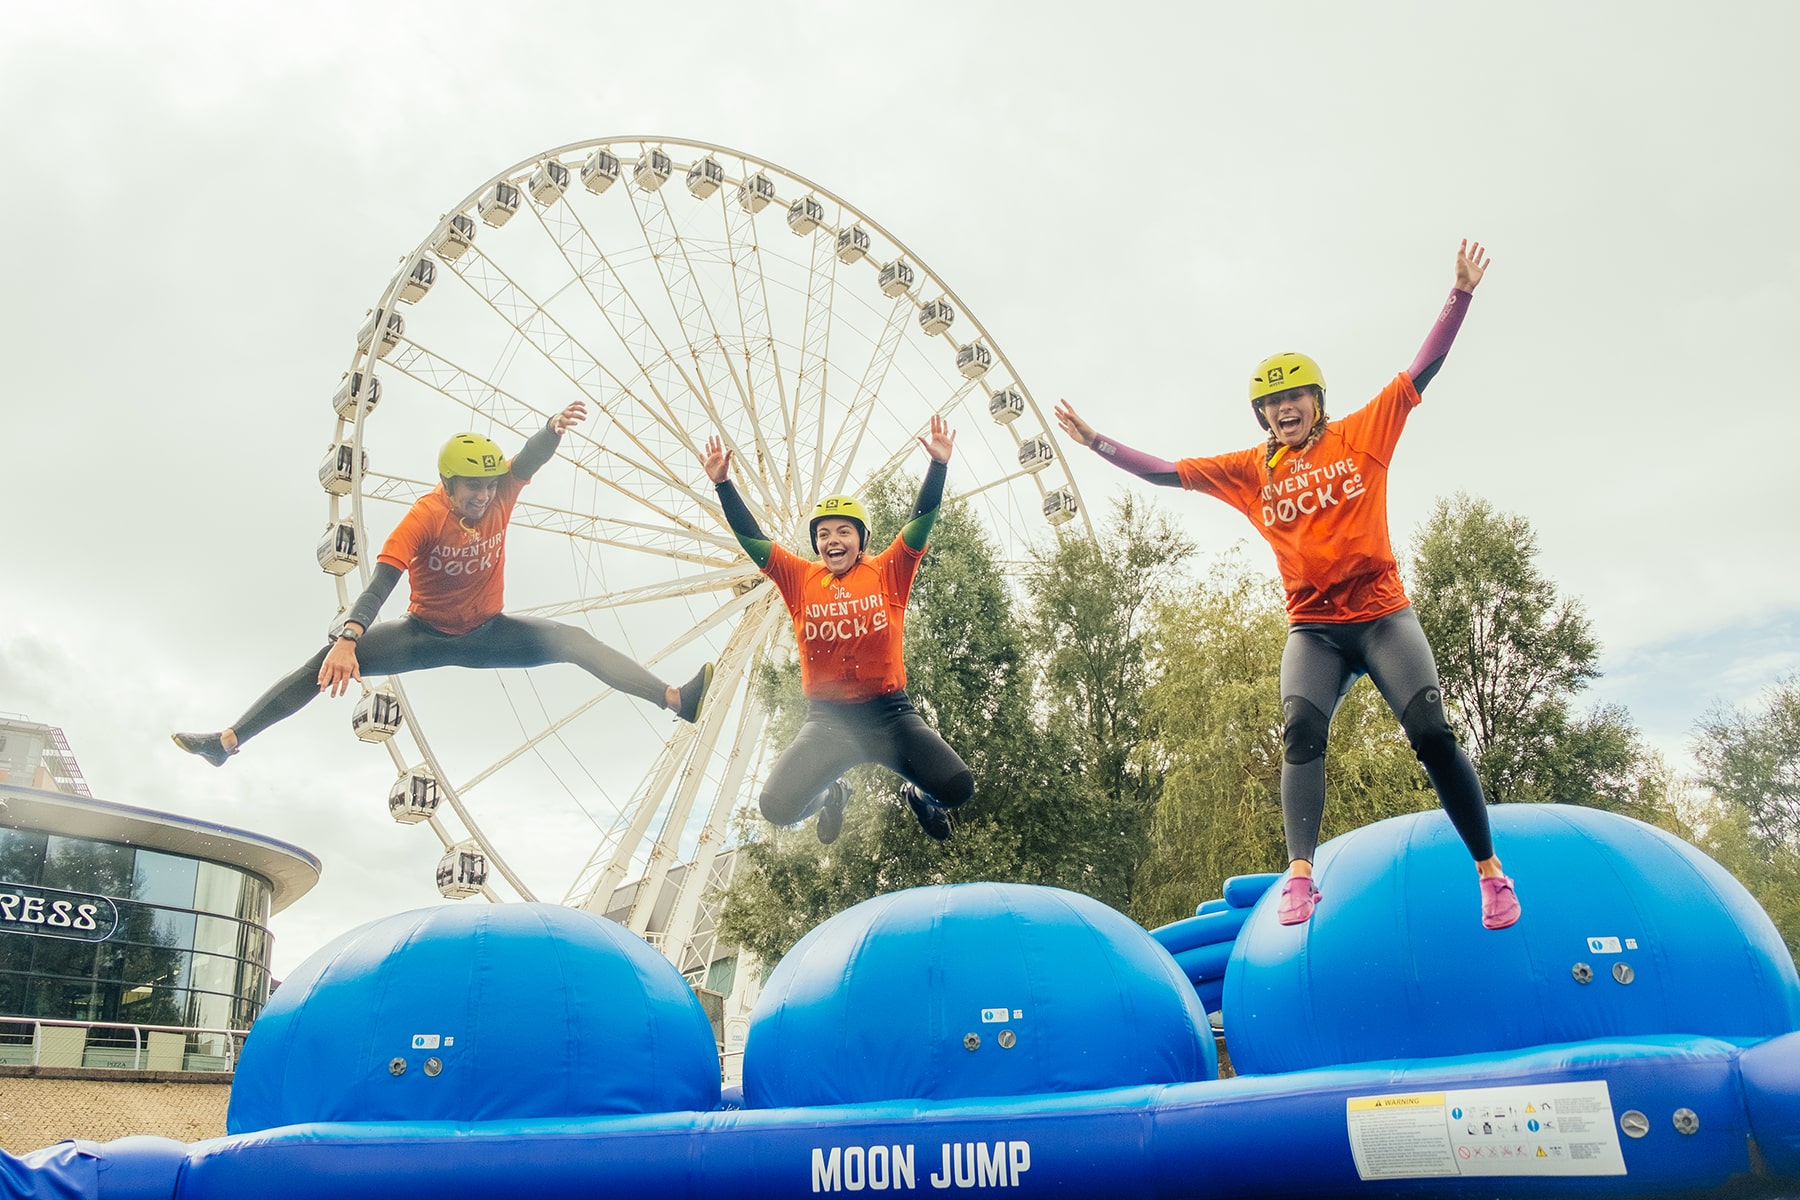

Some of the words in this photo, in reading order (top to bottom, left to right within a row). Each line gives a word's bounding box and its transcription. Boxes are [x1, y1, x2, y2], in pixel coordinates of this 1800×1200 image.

[1283, 458, 1312, 475] The
[829, 584, 852, 599] The
[0, 893, 97, 930] RESS
[1384, 1097, 1420, 1107] WARNING
[811, 1144, 915, 1193] MOON
[930, 1140, 1031, 1190] JUMP
